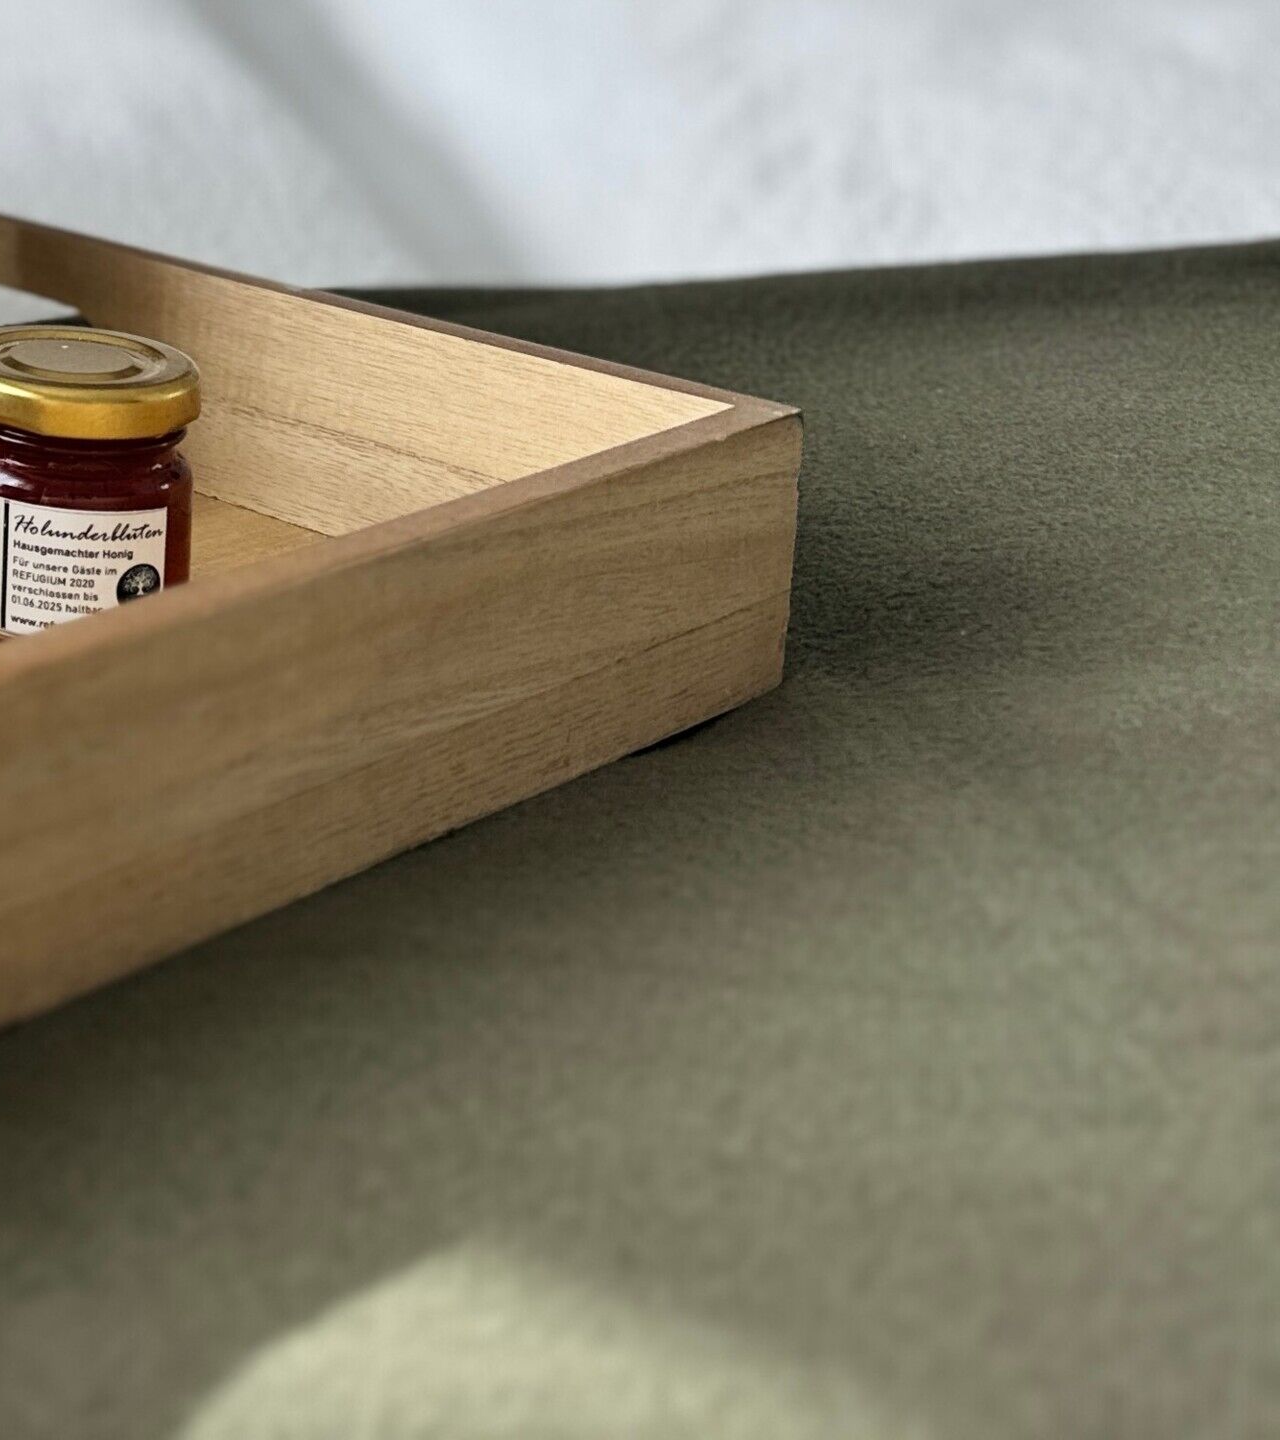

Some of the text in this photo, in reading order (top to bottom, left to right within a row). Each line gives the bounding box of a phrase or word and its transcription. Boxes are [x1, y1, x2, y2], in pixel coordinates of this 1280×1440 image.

[13, 539, 134, 560] Hausgemachter Honig
[12, 555, 118, 576] Für unsere Gäste im
[12, 568, 95, 589] REFUGIUM 2020
[11, 594, 62, 613] 01.06.2025
[12, 584, 99, 602] verschlossen bis
